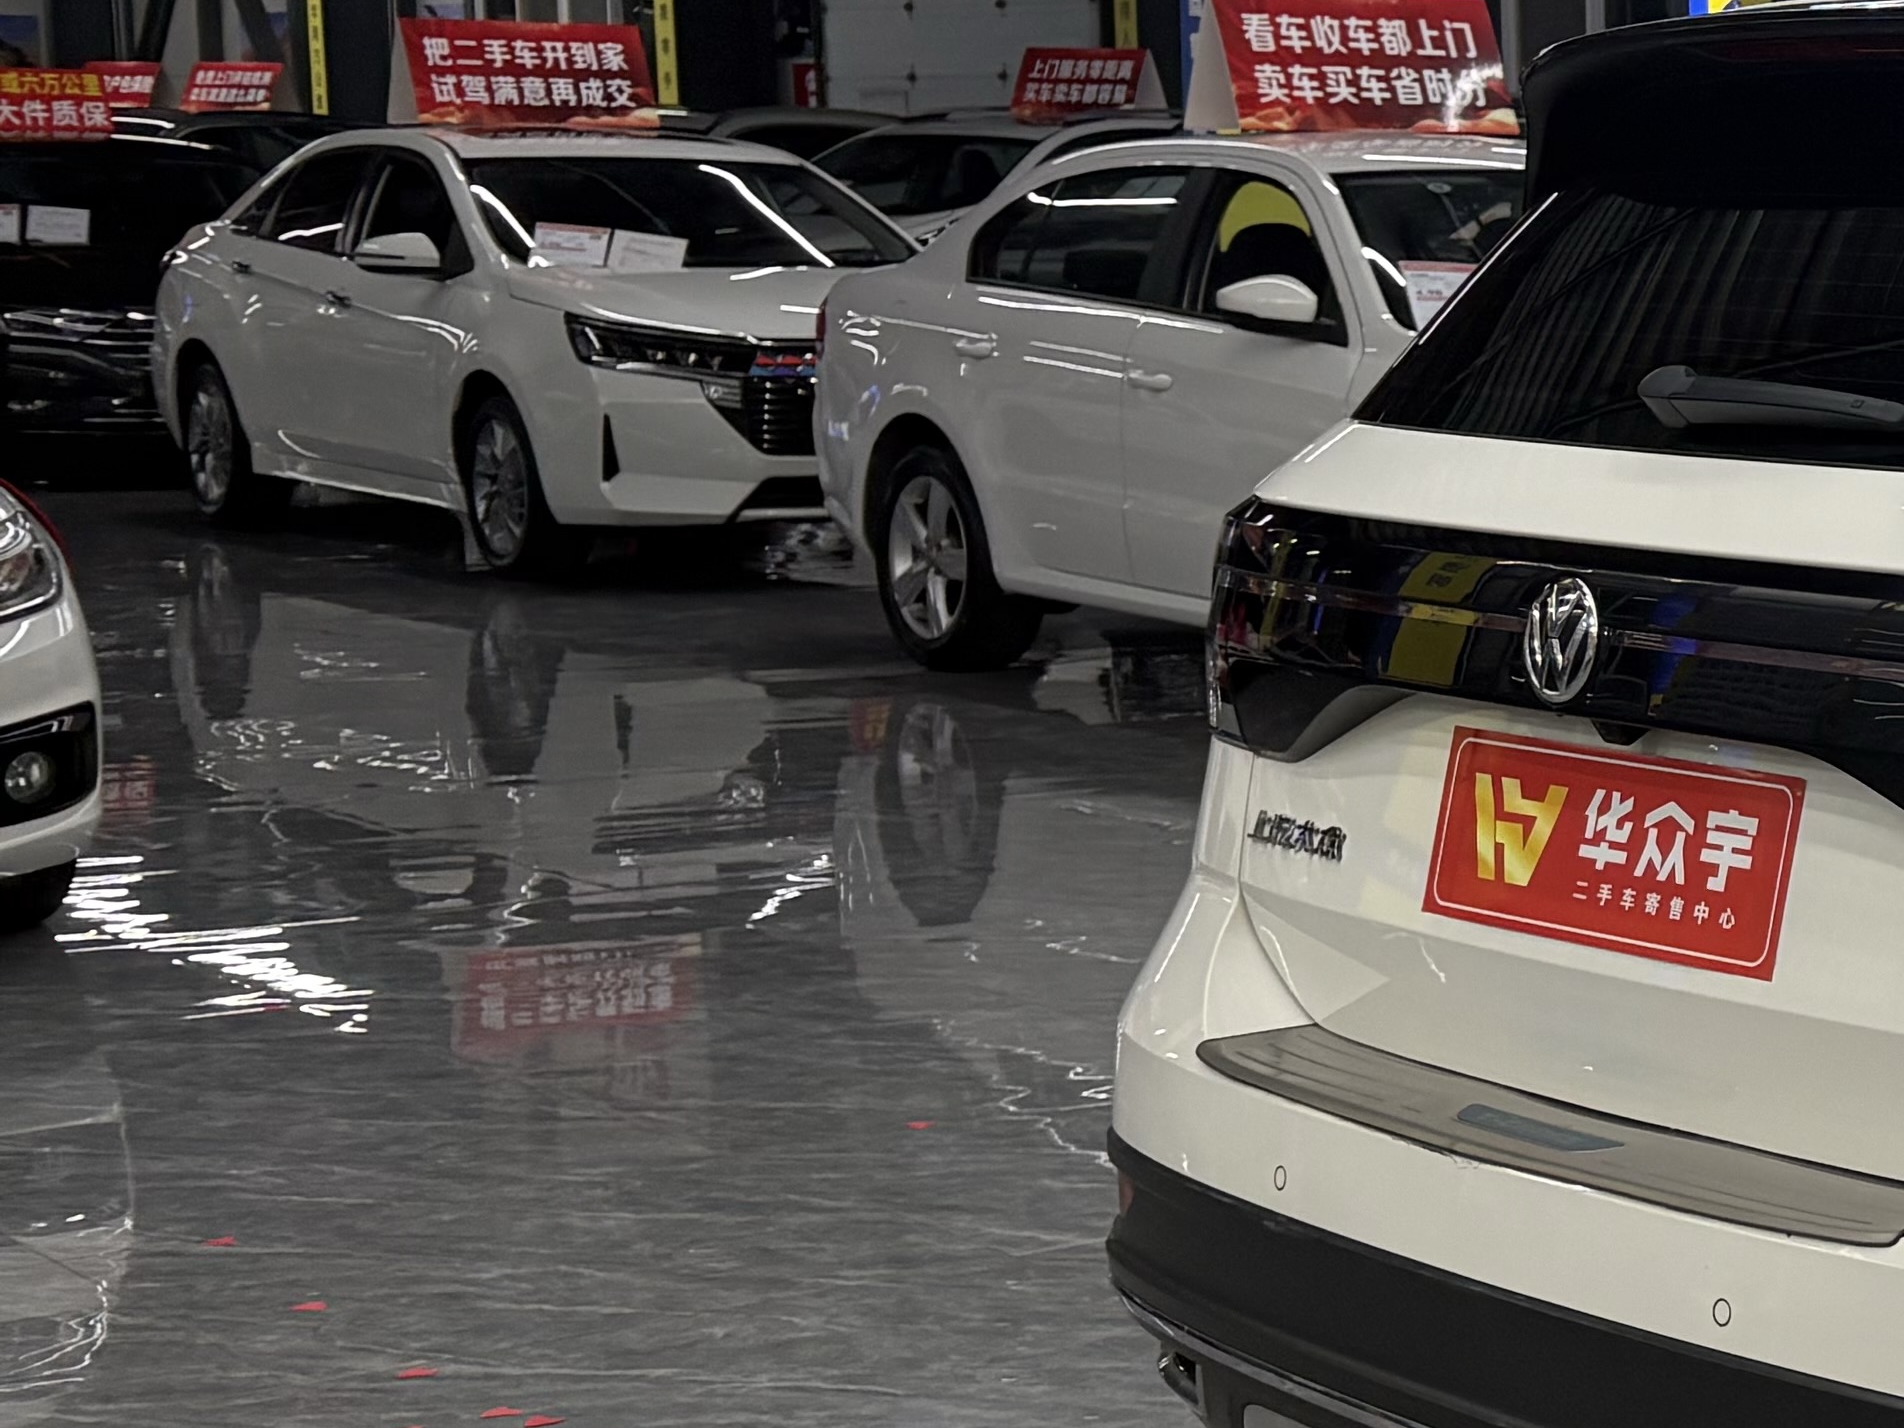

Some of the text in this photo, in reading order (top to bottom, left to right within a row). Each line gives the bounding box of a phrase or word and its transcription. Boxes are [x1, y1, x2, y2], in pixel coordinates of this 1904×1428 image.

[421, 36, 629, 72] 把二手车开到家
[1240, 12, 1478, 59] 看车收车都上门
[431, 73, 639, 109] 试驾满意再成交
[0, 98, 110, 127] 大件质保
[1578, 788, 1760, 893] 华众宇
[1572, 880, 1737, 931] 二手车寄售中心
